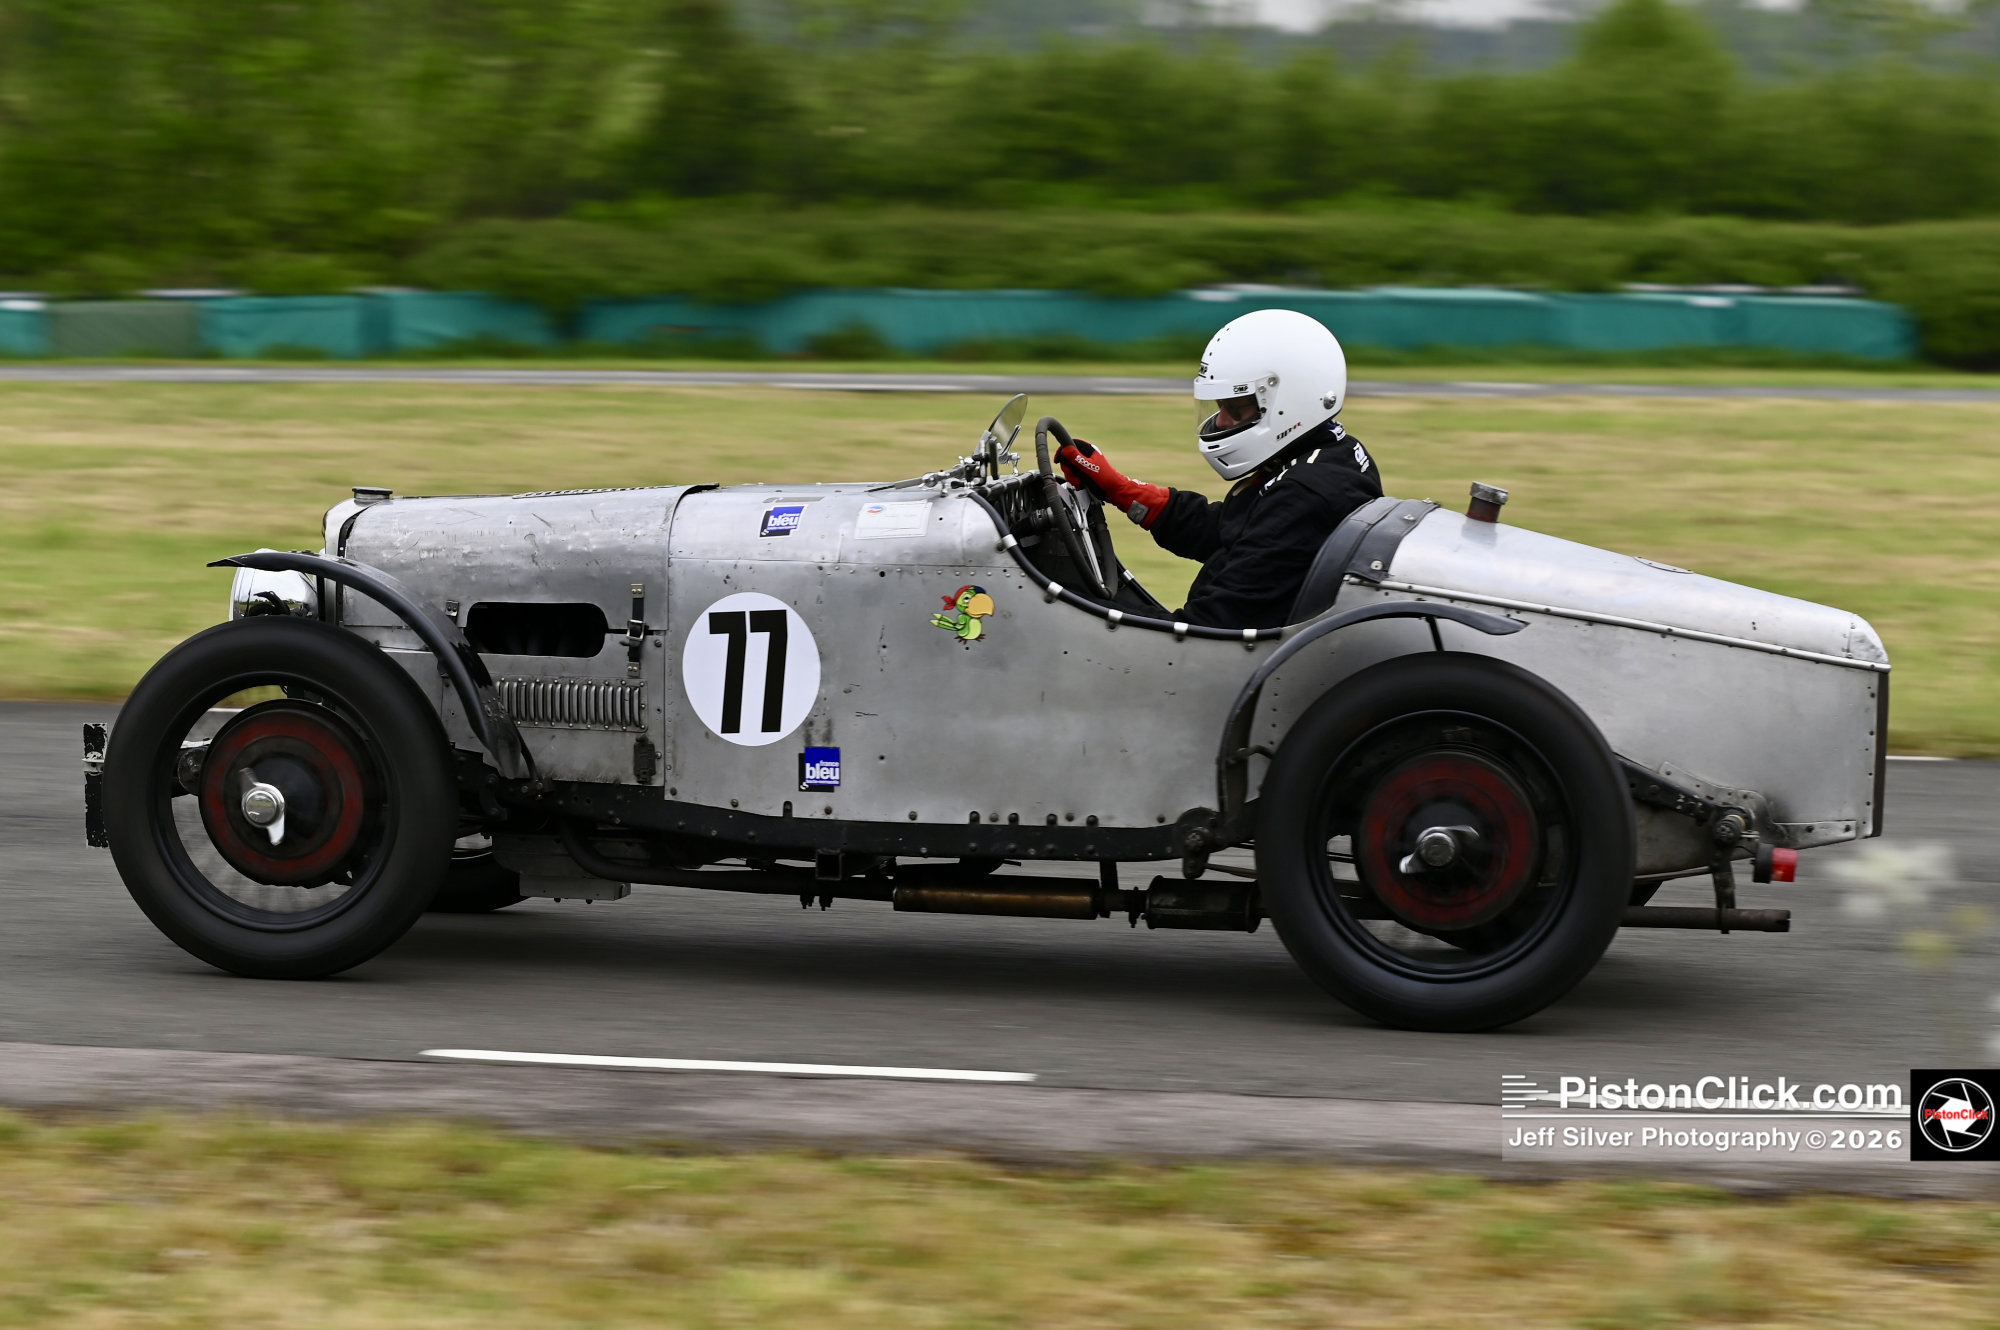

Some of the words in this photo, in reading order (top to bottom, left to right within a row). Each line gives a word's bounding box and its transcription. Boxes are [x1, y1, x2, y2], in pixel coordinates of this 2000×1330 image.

[1233, 385, 1249, 393] OMP
[768, 514, 800, 527] bleu
[708, 609, 788, 734] 77
[805, 762, 840, 780] bleu
